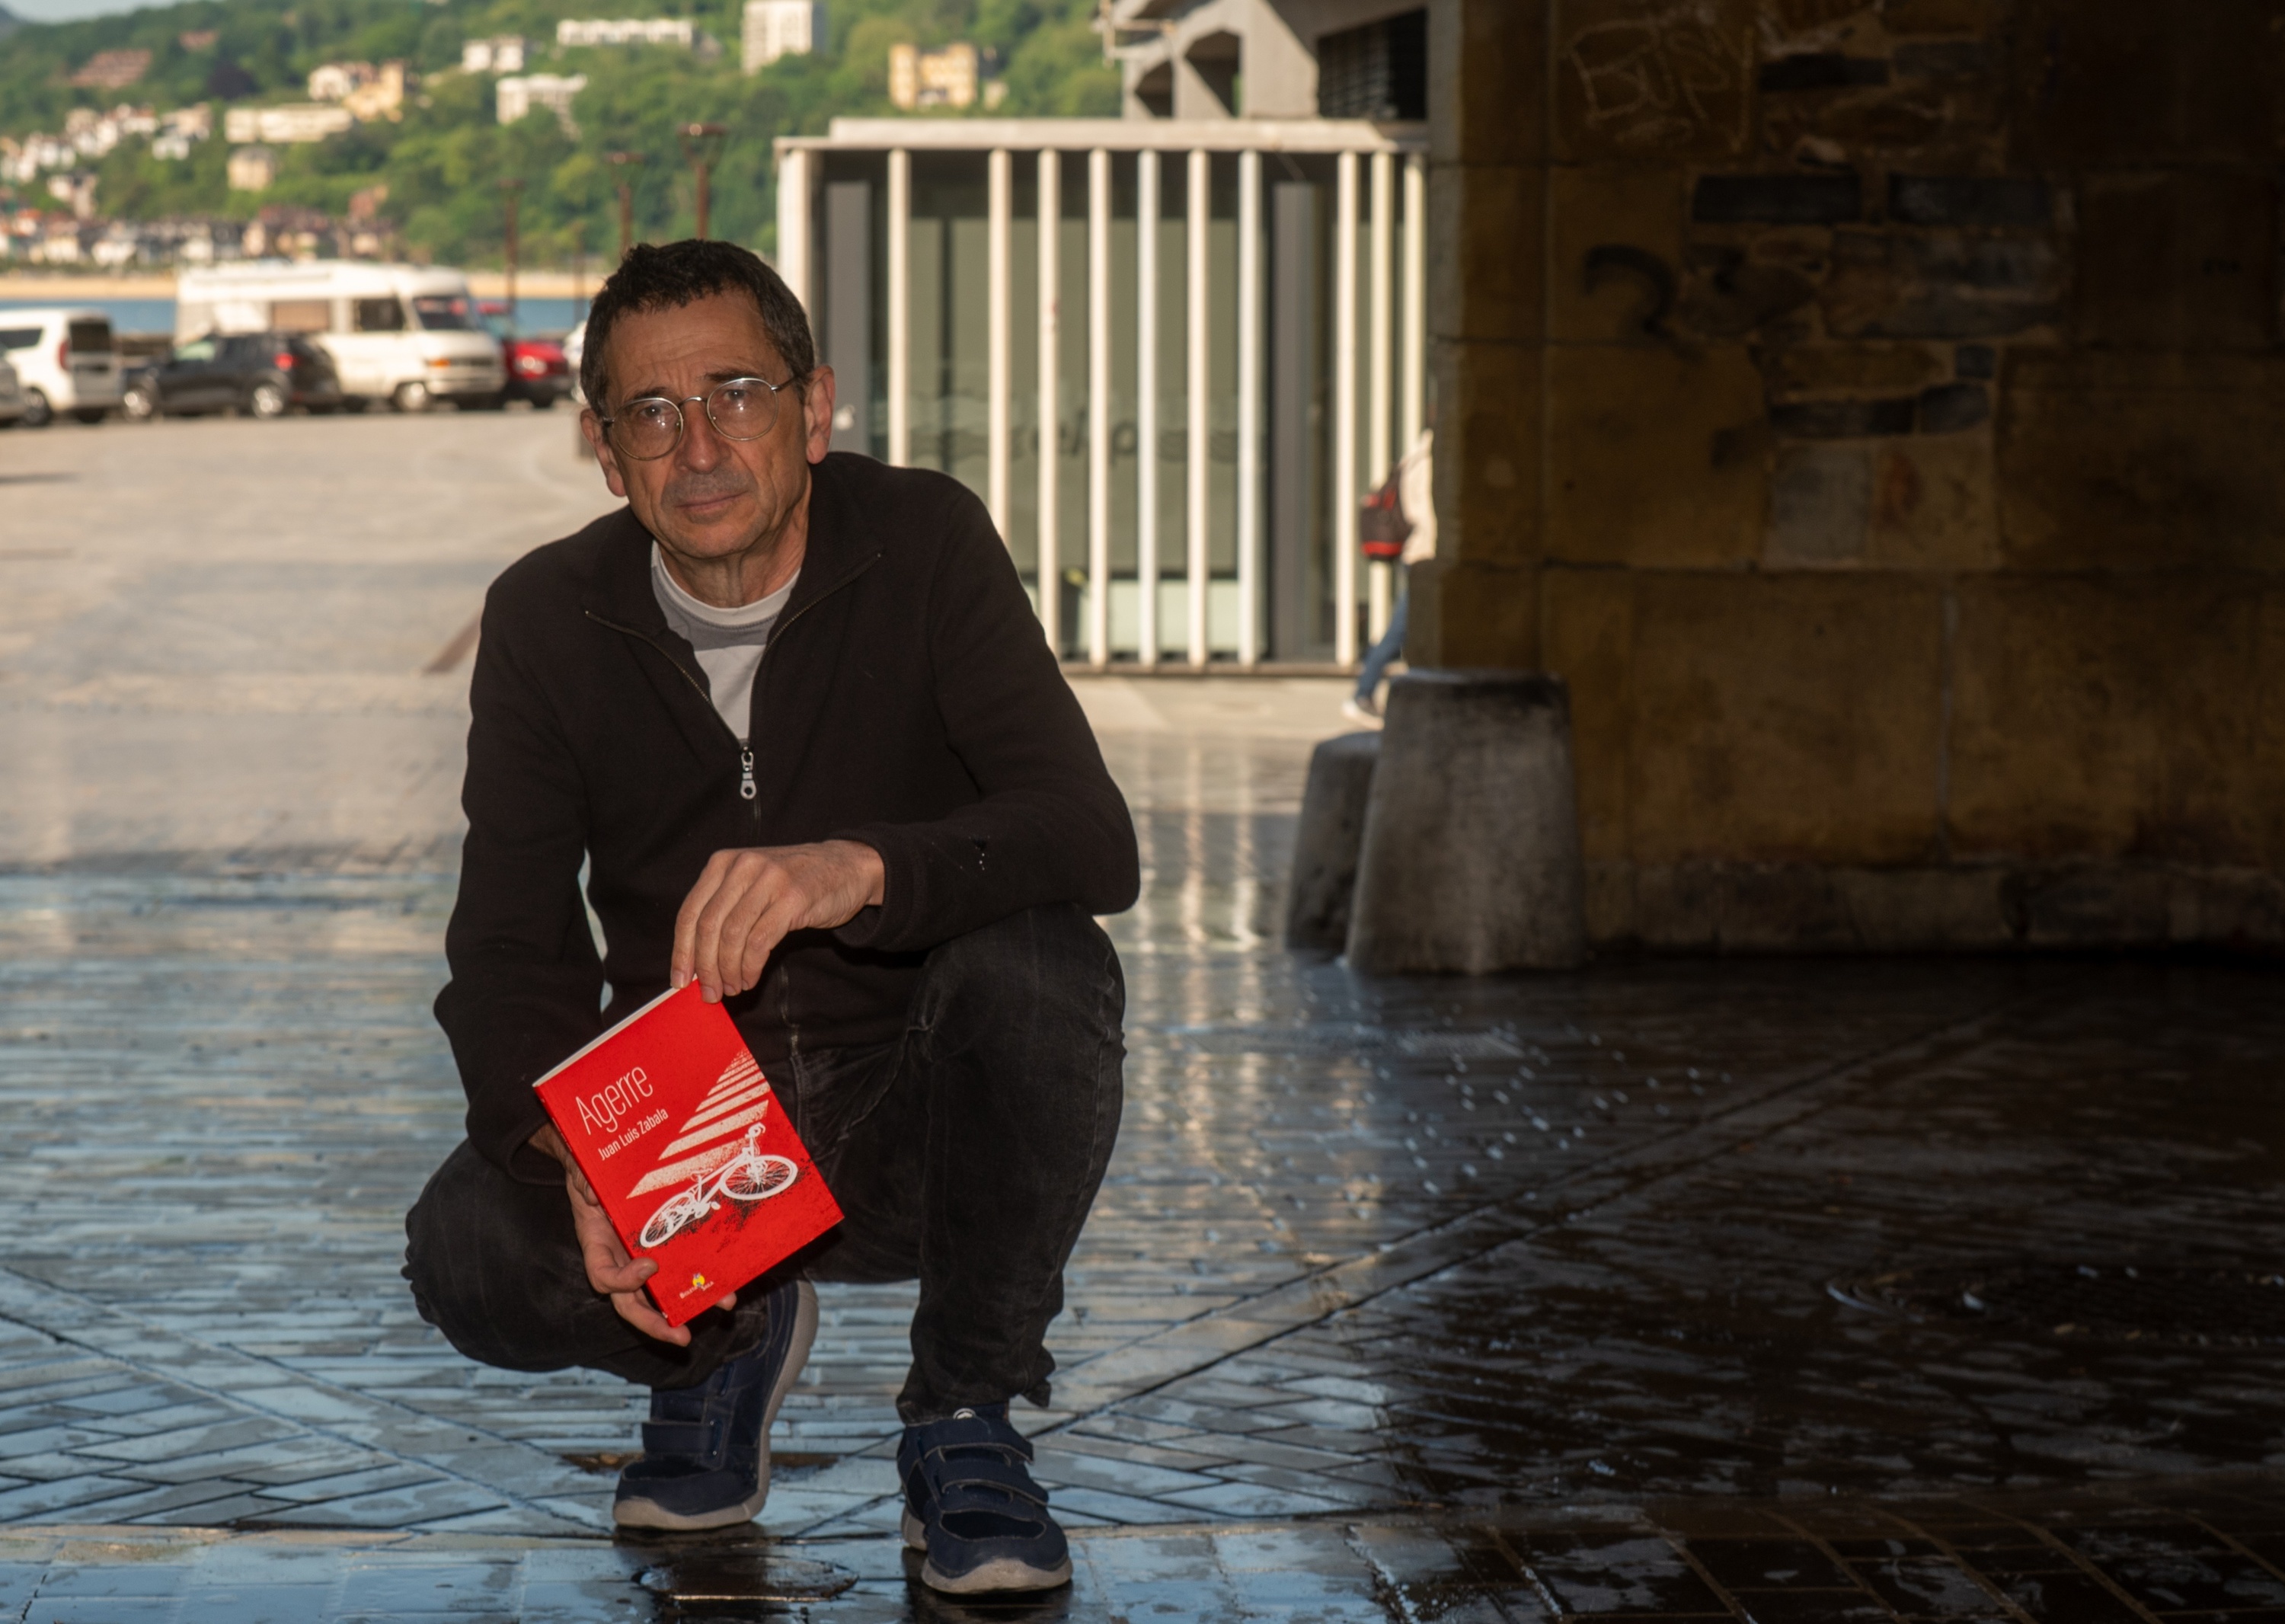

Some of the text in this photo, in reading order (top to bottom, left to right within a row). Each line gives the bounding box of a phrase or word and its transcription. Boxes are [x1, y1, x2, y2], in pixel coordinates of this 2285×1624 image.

[575, 1066, 654, 1136] Agerre
[598, 1108, 669, 1161] Juan Luis Zabala
